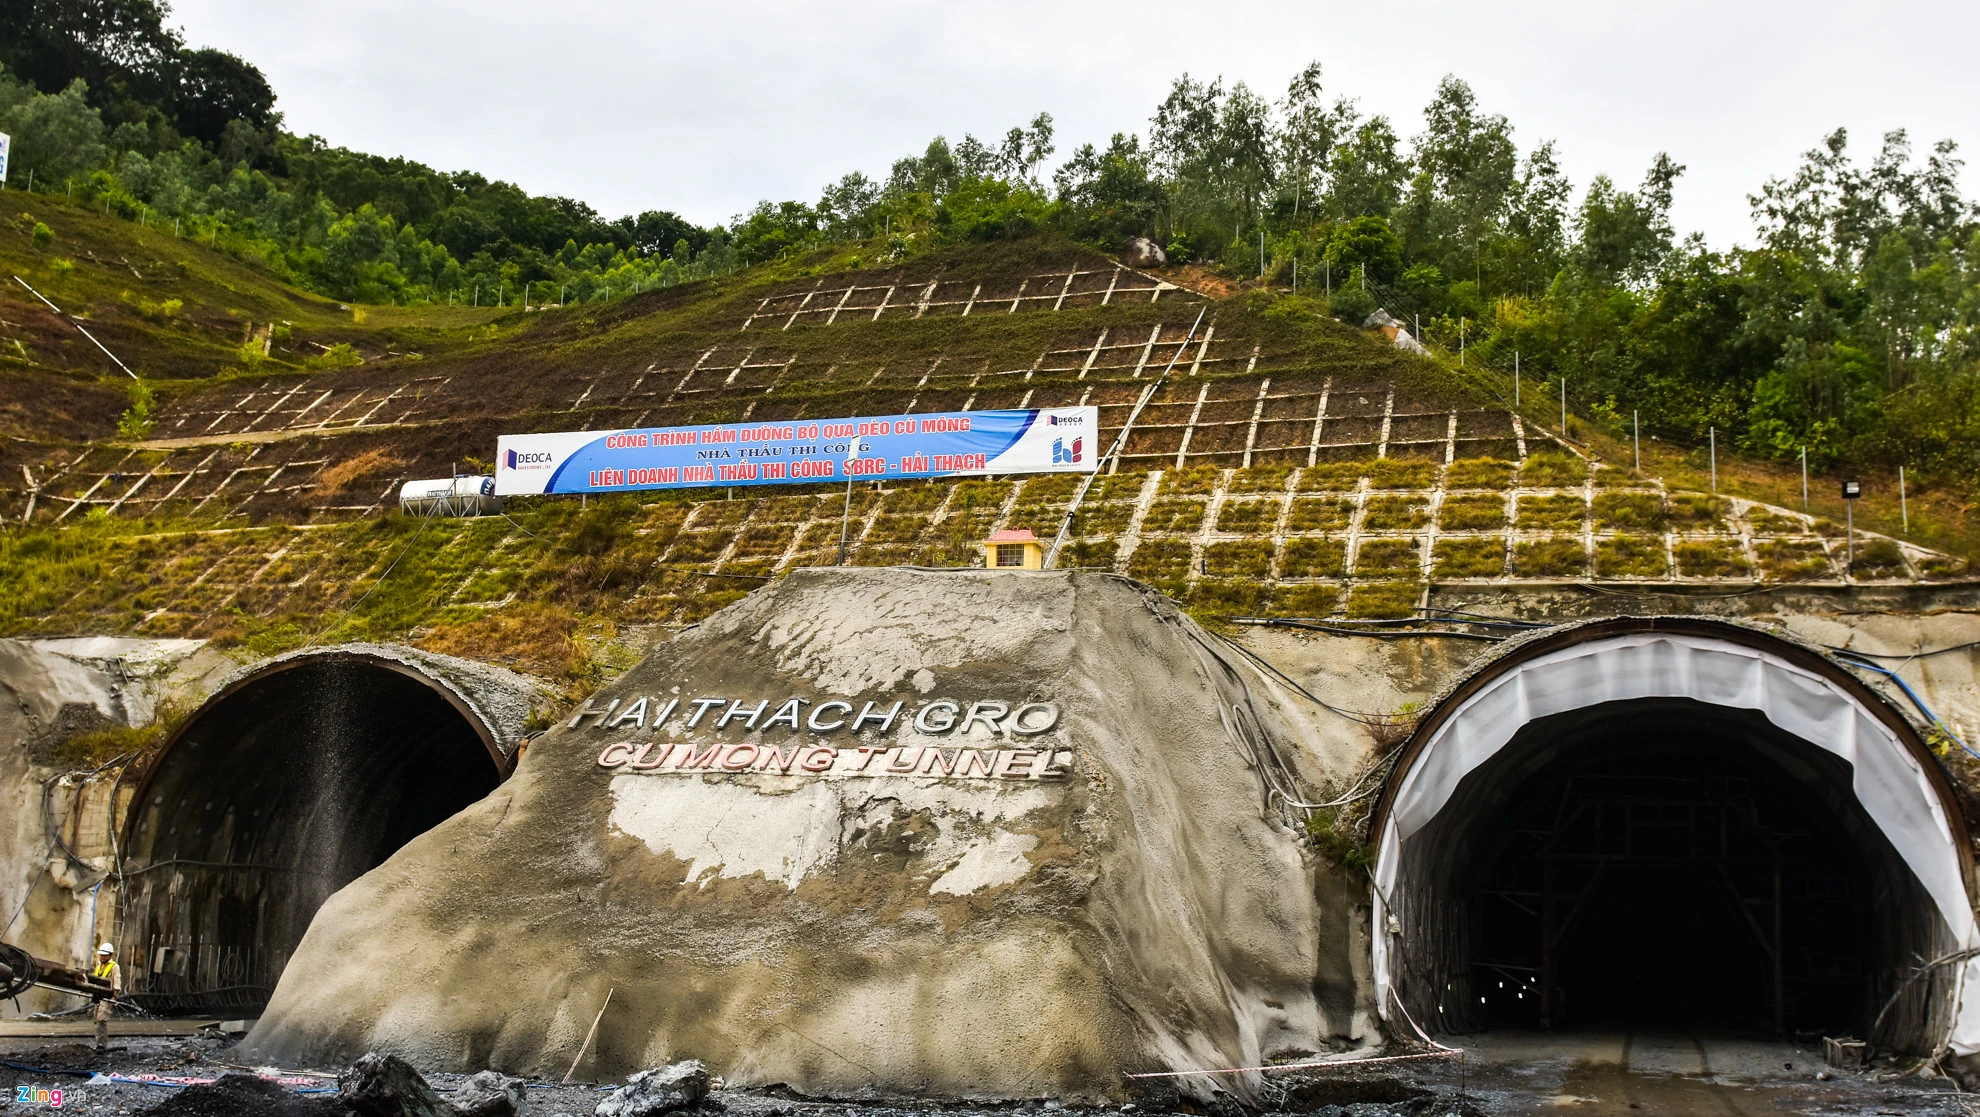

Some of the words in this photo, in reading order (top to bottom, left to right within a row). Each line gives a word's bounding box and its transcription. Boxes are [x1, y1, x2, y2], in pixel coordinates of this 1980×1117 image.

[606, 433, 647, 449] CÔNG
[652, 430, 697, 446] TRÌNH
[741, 425, 793, 443] ĐƯỜNG
[797, 423, 819, 443] BỘ
[823, 422, 855, 440] QUA
[857, 419, 890, 437] ĐÈO
[894, 417, 918, 435] CÙ
[921, 416, 971, 433] MÔNG
[518, 453, 552, 463] DEOCA
[697, 447, 731, 460] NHÀ
[789, 445, 818, 455] THI
[590, 467, 623, 487] LIÊN
[628, 467, 678, 484] DOANH
[682, 462, 715, 482] NHÀ
[761, 461, 786, 479] THI
[790, 458, 833, 478] CÔNG
[842, 458, 886, 476] SBRC
[902, 452, 929, 473] HẢI
[933, 453, 986, 474] THẠCH
[566, 697, 680, 730] HAI
[913, 701, 1058, 736] GRO
[857, 746, 1064, 778] TUNNEL
